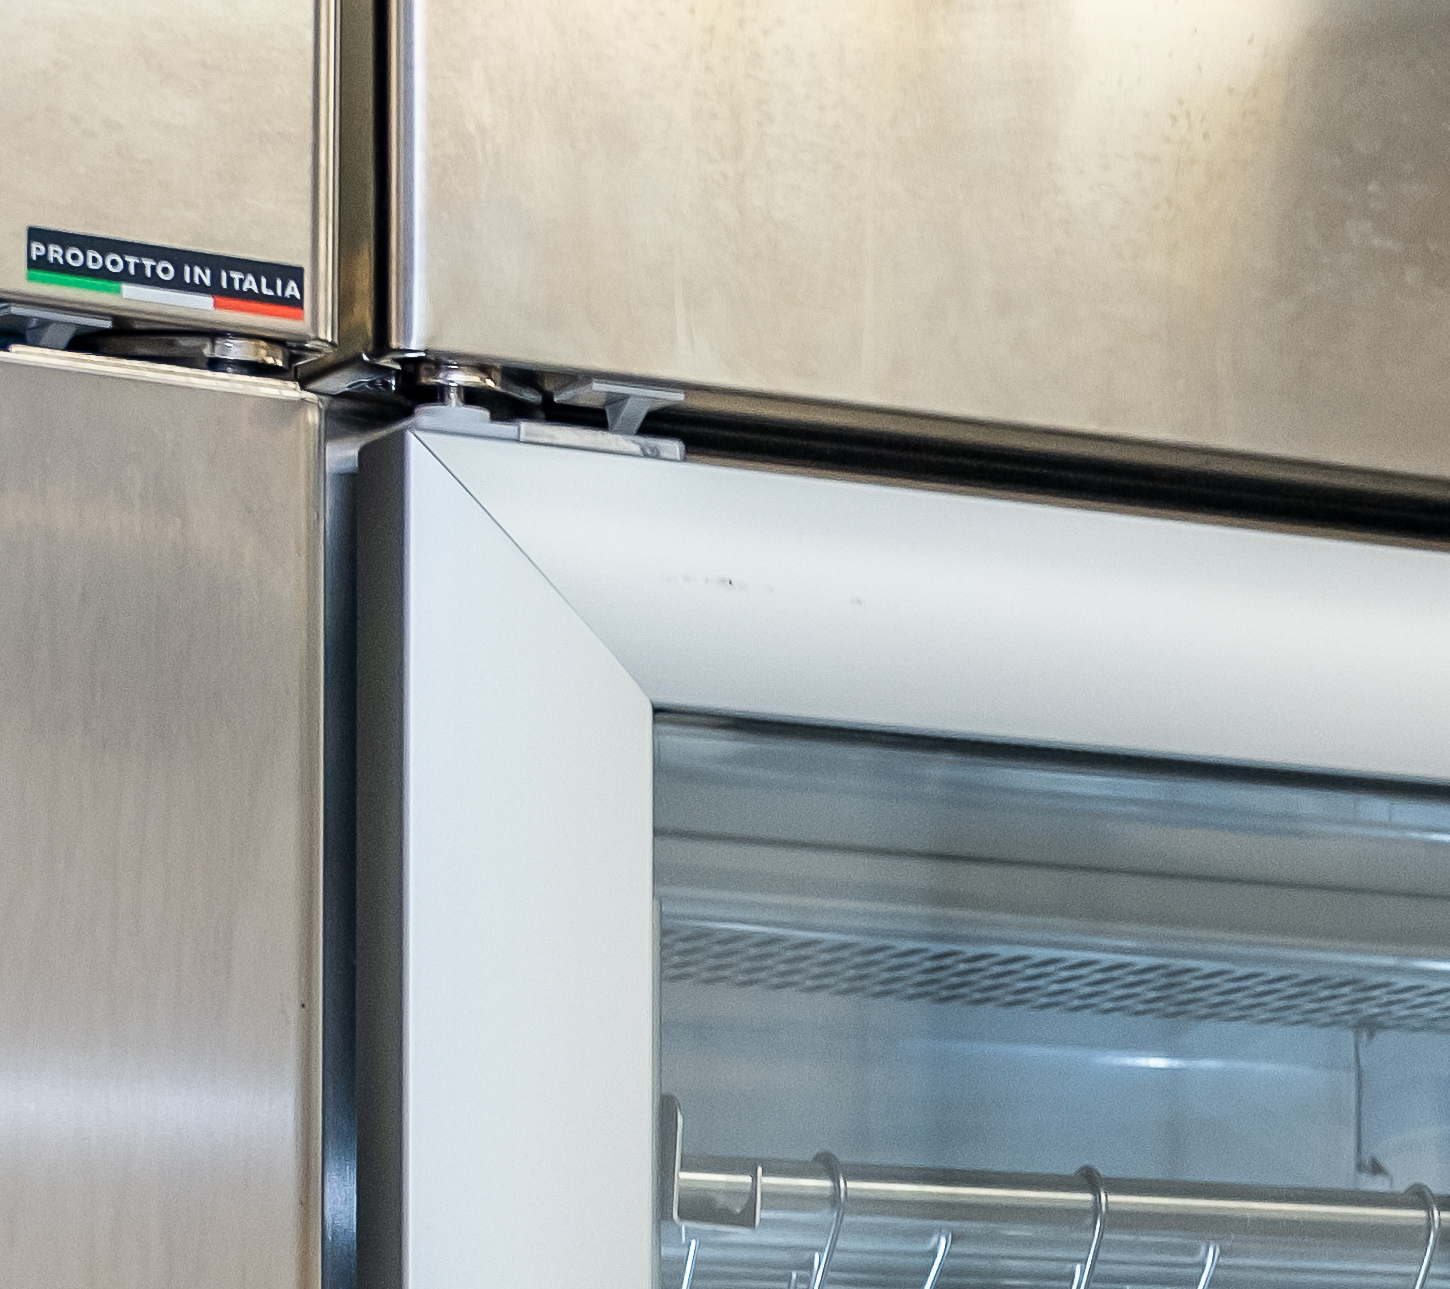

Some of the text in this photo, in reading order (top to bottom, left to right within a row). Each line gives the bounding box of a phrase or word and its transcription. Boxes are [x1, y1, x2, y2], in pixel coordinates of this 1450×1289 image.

[30, 240, 302, 300] PRODOTTO IN ITALIA
